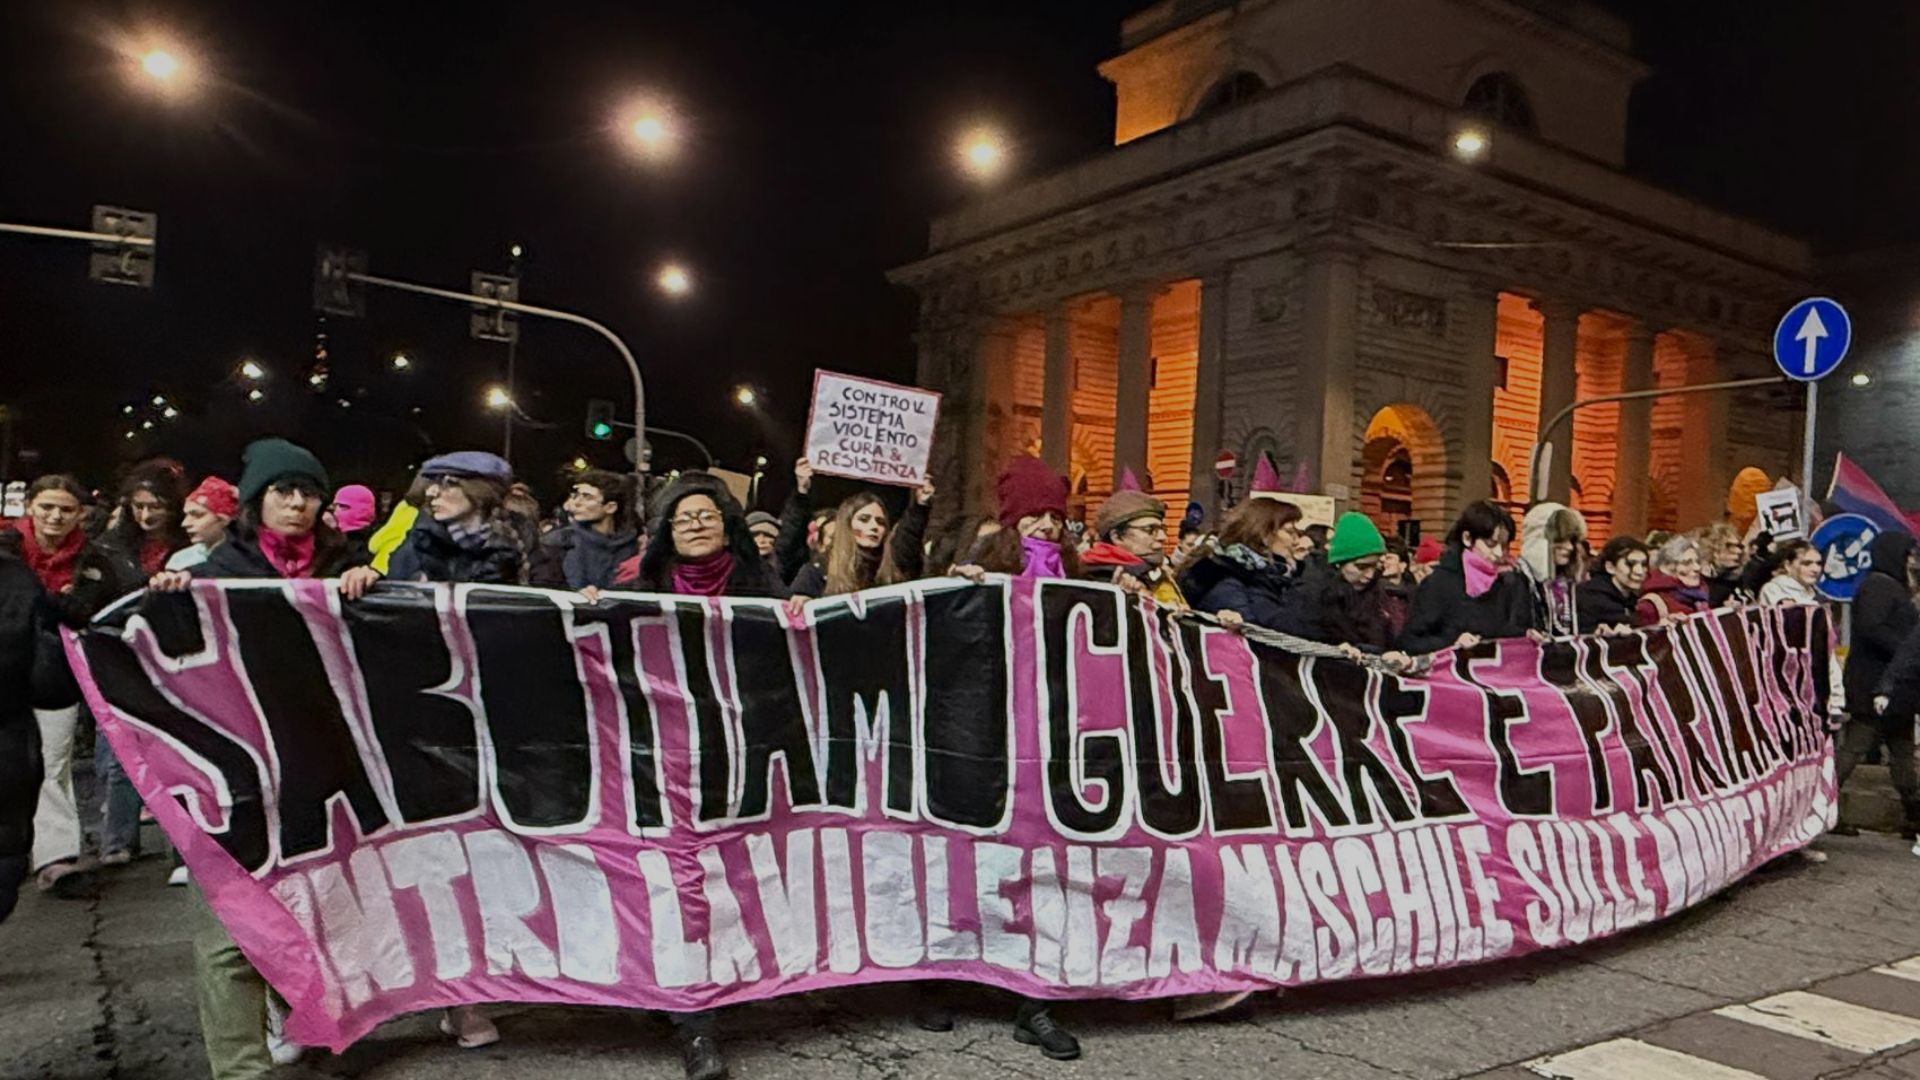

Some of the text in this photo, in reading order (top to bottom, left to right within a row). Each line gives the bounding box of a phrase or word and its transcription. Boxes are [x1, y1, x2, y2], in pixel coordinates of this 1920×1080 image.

[842, 387, 910, 411] CONTRO
[829, 402, 905, 429] SISTEMA
[833, 421, 918, 448] VIOLENTO
[839, 438, 902, 461] CURA &
[817, 450, 917, 479] RESISTENZA
[84, 575, 1016, 880] SABOTIAMO
[1033, 577, 1477, 837] GUERRE
[1450, 640, 1556, 821] E
[637, 844, 761, 987] LA
[746, 827, 1204, 986] VIOLENZA
[1213, 824, 1514, 981] MASCHILE
[1505, 813, 1658, 946] SULLE
